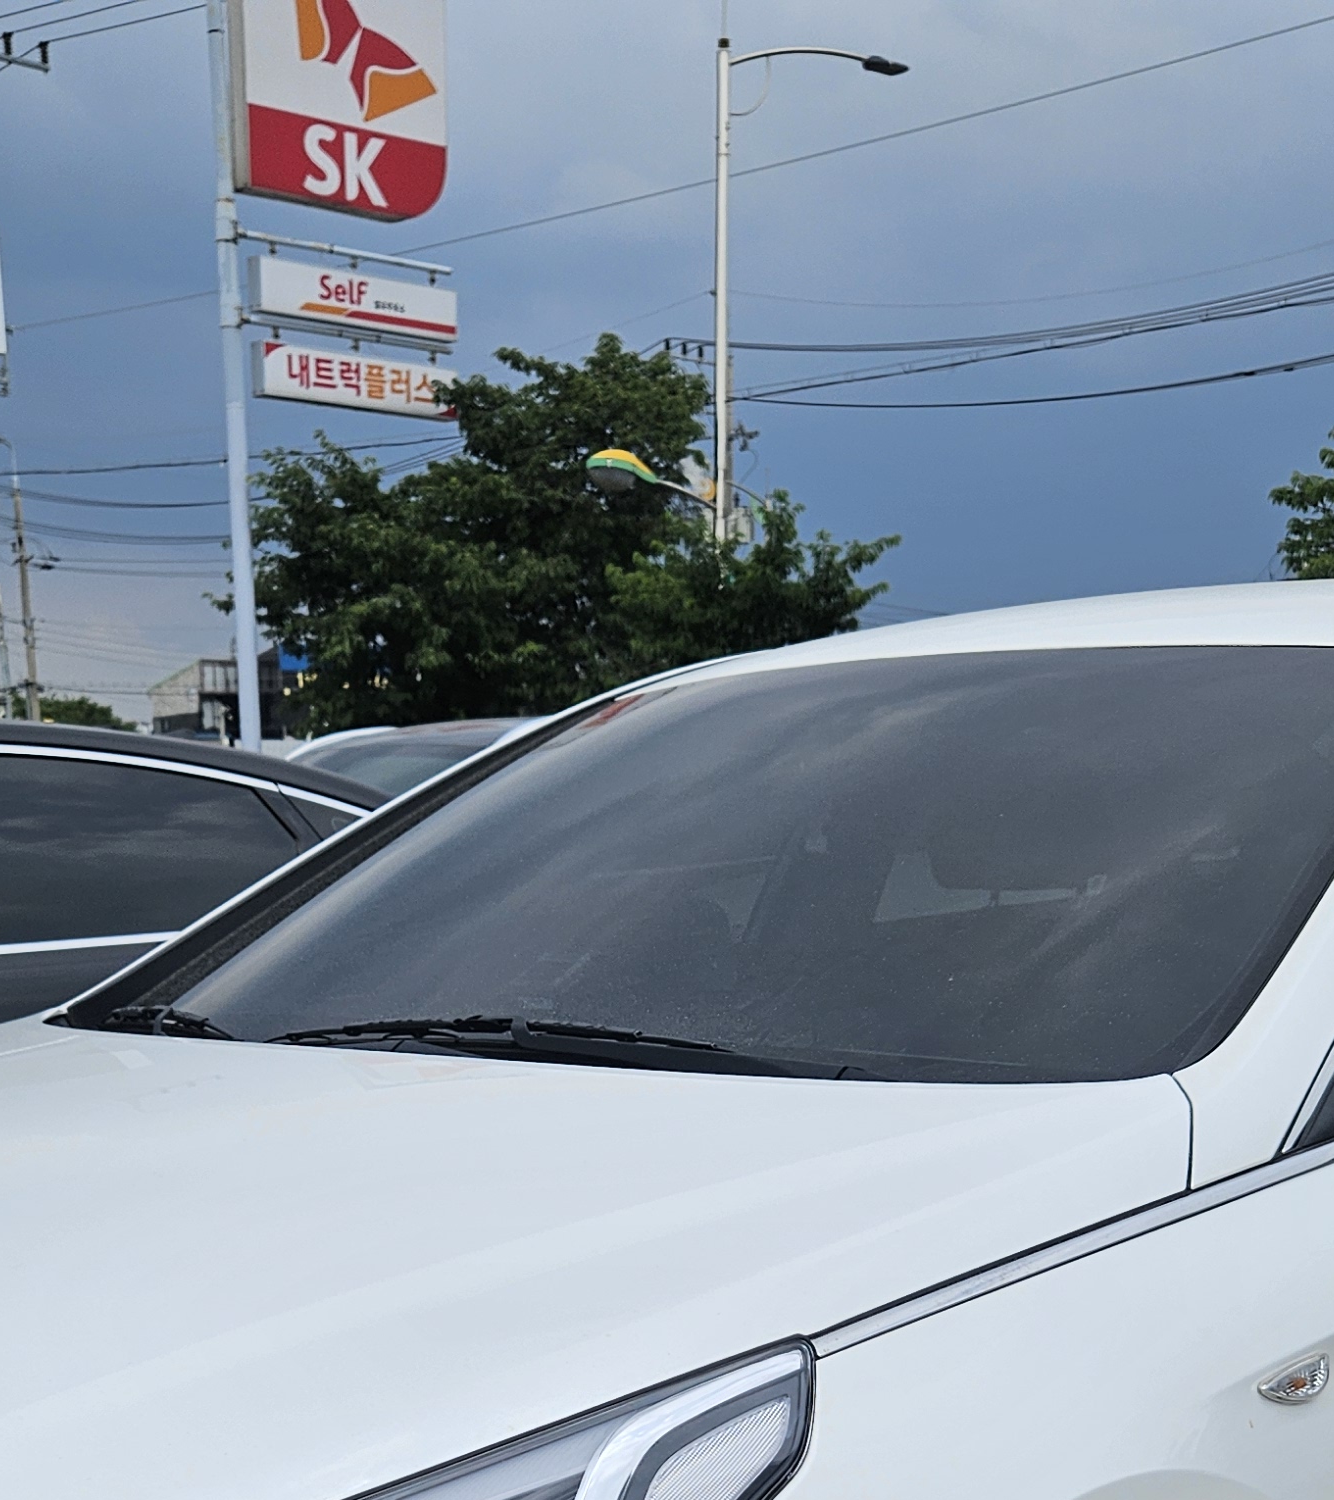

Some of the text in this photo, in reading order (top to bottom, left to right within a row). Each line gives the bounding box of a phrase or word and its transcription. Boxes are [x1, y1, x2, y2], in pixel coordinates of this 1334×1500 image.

[302, 123, 389, 208] SK
[319, 275, 369, 305] Self
[287, 354, 436, 404] 내트럭플러스
